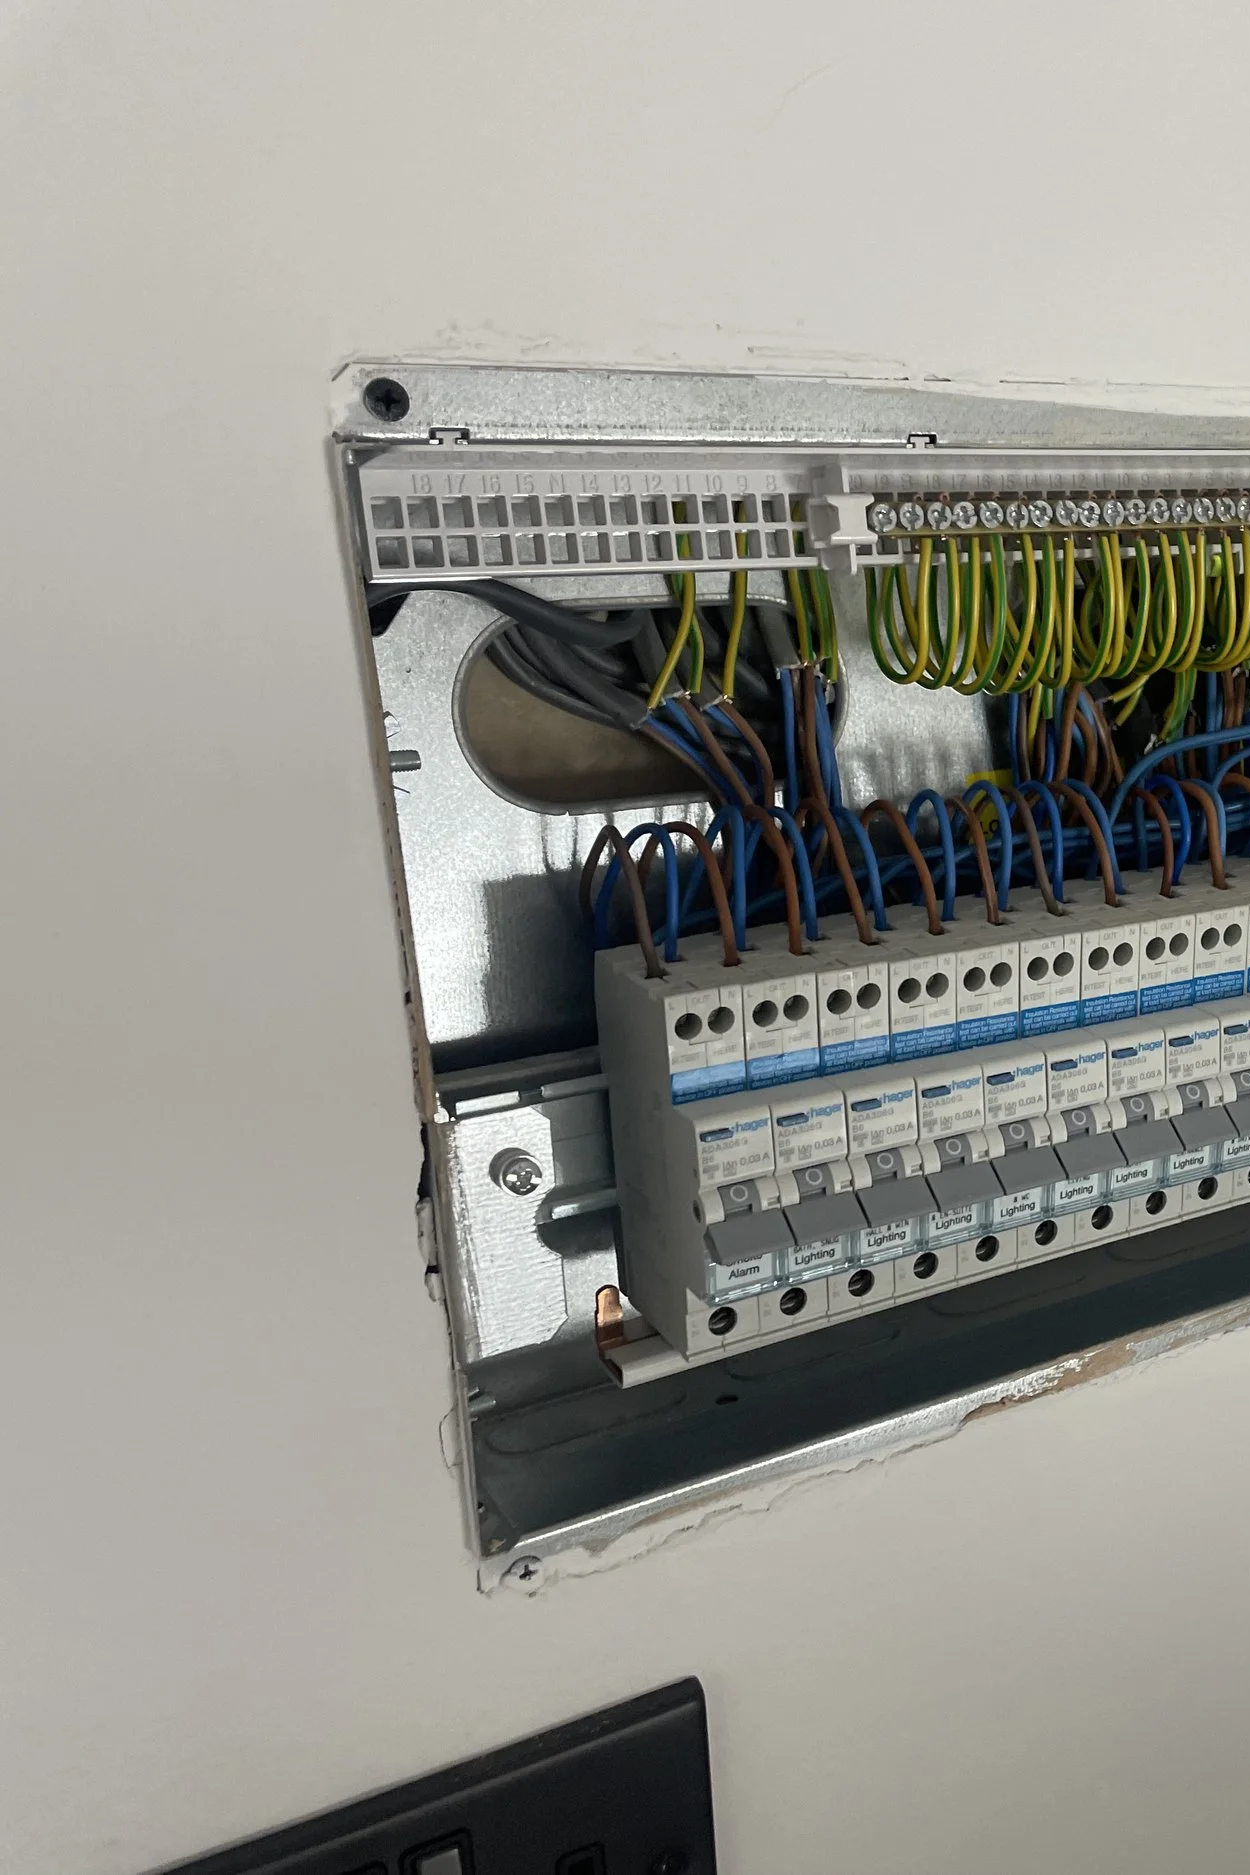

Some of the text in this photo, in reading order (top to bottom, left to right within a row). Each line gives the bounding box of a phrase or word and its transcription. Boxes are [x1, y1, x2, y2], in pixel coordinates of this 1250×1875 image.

[411, 473, 432, 495] 18
[446, 473, 466, 494] 17
[481, 473, 501, 494] 16
[515, 473, 535, 494] 15
[550, 473, 566, 494] N
[581, 473, 600, 494] 14
[612, 473, 632, 494] 13
[644, 473, 664, 494] 12
[675, 474, 691, 494] 11
[704, 474, 723, 493] 10
[736, 475, 748, 494] 9
[765, 474, 778, 493] 8
[1194, 1028, 1219, 1041] hager
[1138, 1040, 1164, 1052] hager
[1078, 1051, 1106, 1065] hager
[1016, 1063, 1045, 1077] hager
[952, 1076, 982, 1091] hager
[883, 1088, 914, 1104] hager
[810, 1103, 843, 1119] hager
[735, 1117, 770, 1133] hager
[1173, 1155, 1204, 1170] Lighting
[1115, 1168, 1148, 1184] Lighting
[1059, 1184, 1094, 1200] Lighting
[1000, 1201, 1036, 1218] Lighting
[935, 1213, 972, 1231] Lighting
[867, 1230, 907, 1248] Lighting
[795, 1248, 835, 1266] Lighting
[728, 1265, 760, 1281] Alarm
